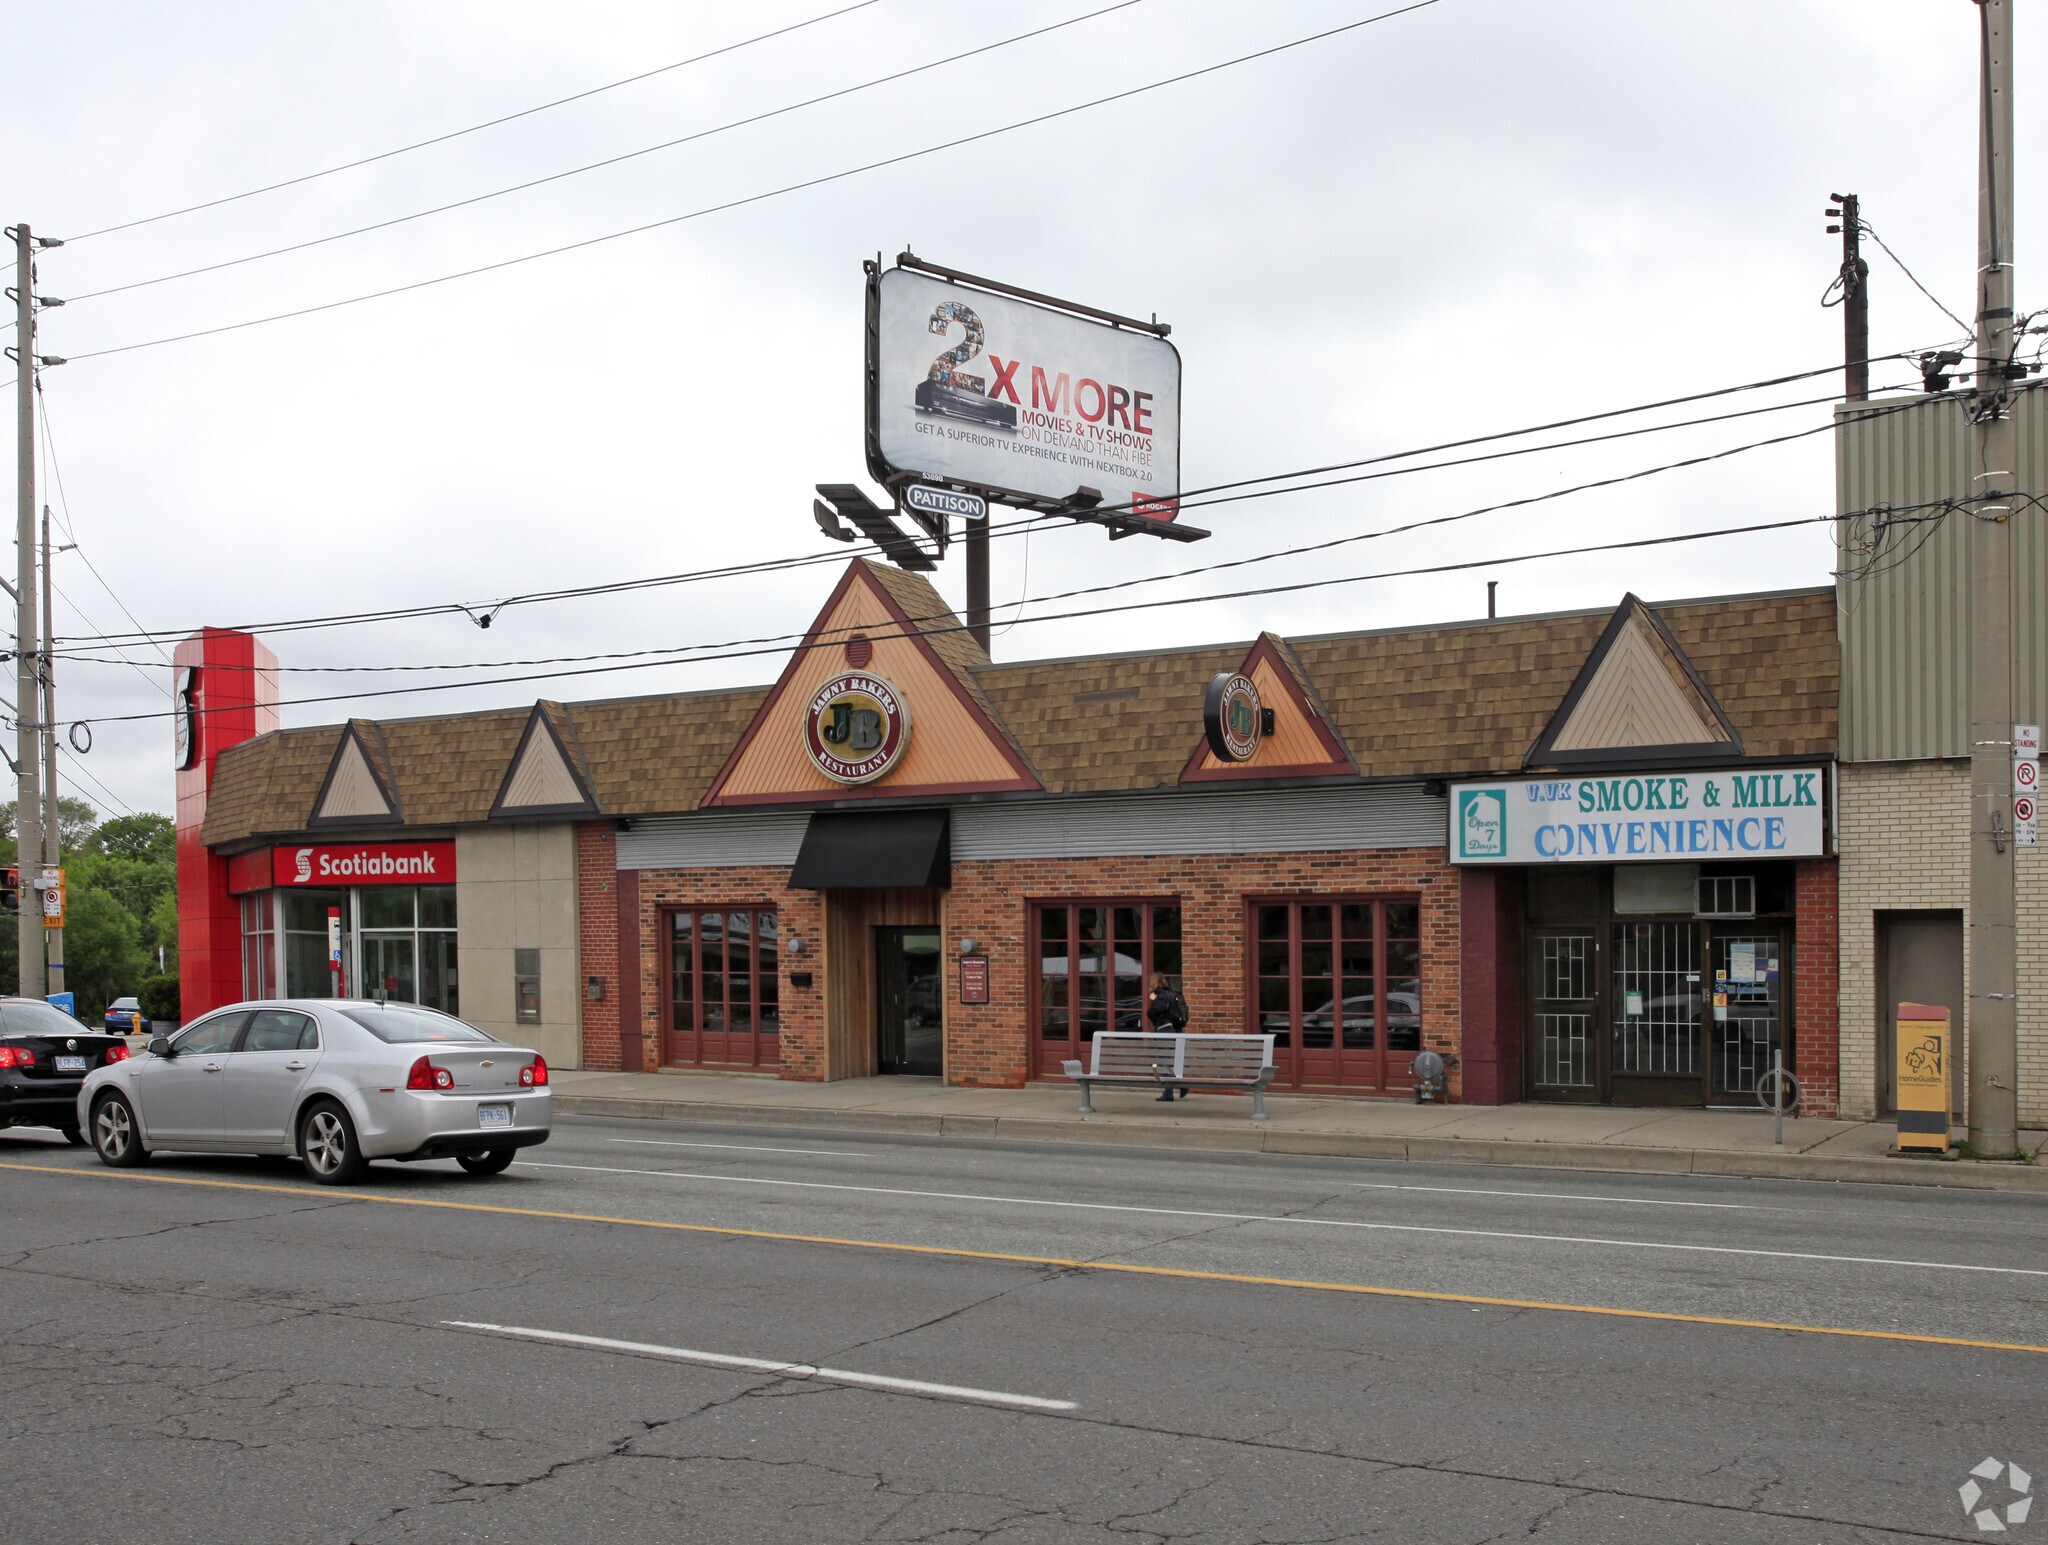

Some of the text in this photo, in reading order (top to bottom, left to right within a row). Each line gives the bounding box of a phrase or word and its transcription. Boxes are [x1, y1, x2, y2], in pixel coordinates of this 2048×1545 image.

[1031, 365, 1154, 435] MORE
[1022, 410, 1153, 452] MOVIES & TV SHOWS
[915, 421, 1153, 482] GET A SUPERIOR TV EXPERIENCE WITH NEXTBOX 2.0
[1022, 426, 1153, 468] ON DEMAND THAN FIBE
[914, 490, 980, 515] PATTISON
[811, 678, 897, 715] JAWNY BAKERS
[2023, 729, 2030, 737] NO
[818, 750, 888, 776] RESTAURANT
[1578, 777, 1690, 813] SMOKE
[1702, 780, 1721, 808] &
[1732, 773, 1817, 808] MILK
[1468, 816, 1499, 832] Open
[1485, 829, 1495, 843] 7
[1534, 816, 1787, 858] CONVENIENCE
[1468, 839, 1498, 853] Days
[319, 850, 436, 876] Scotiabank
[1899, 1074, 1942, 1083] HomeGuides
